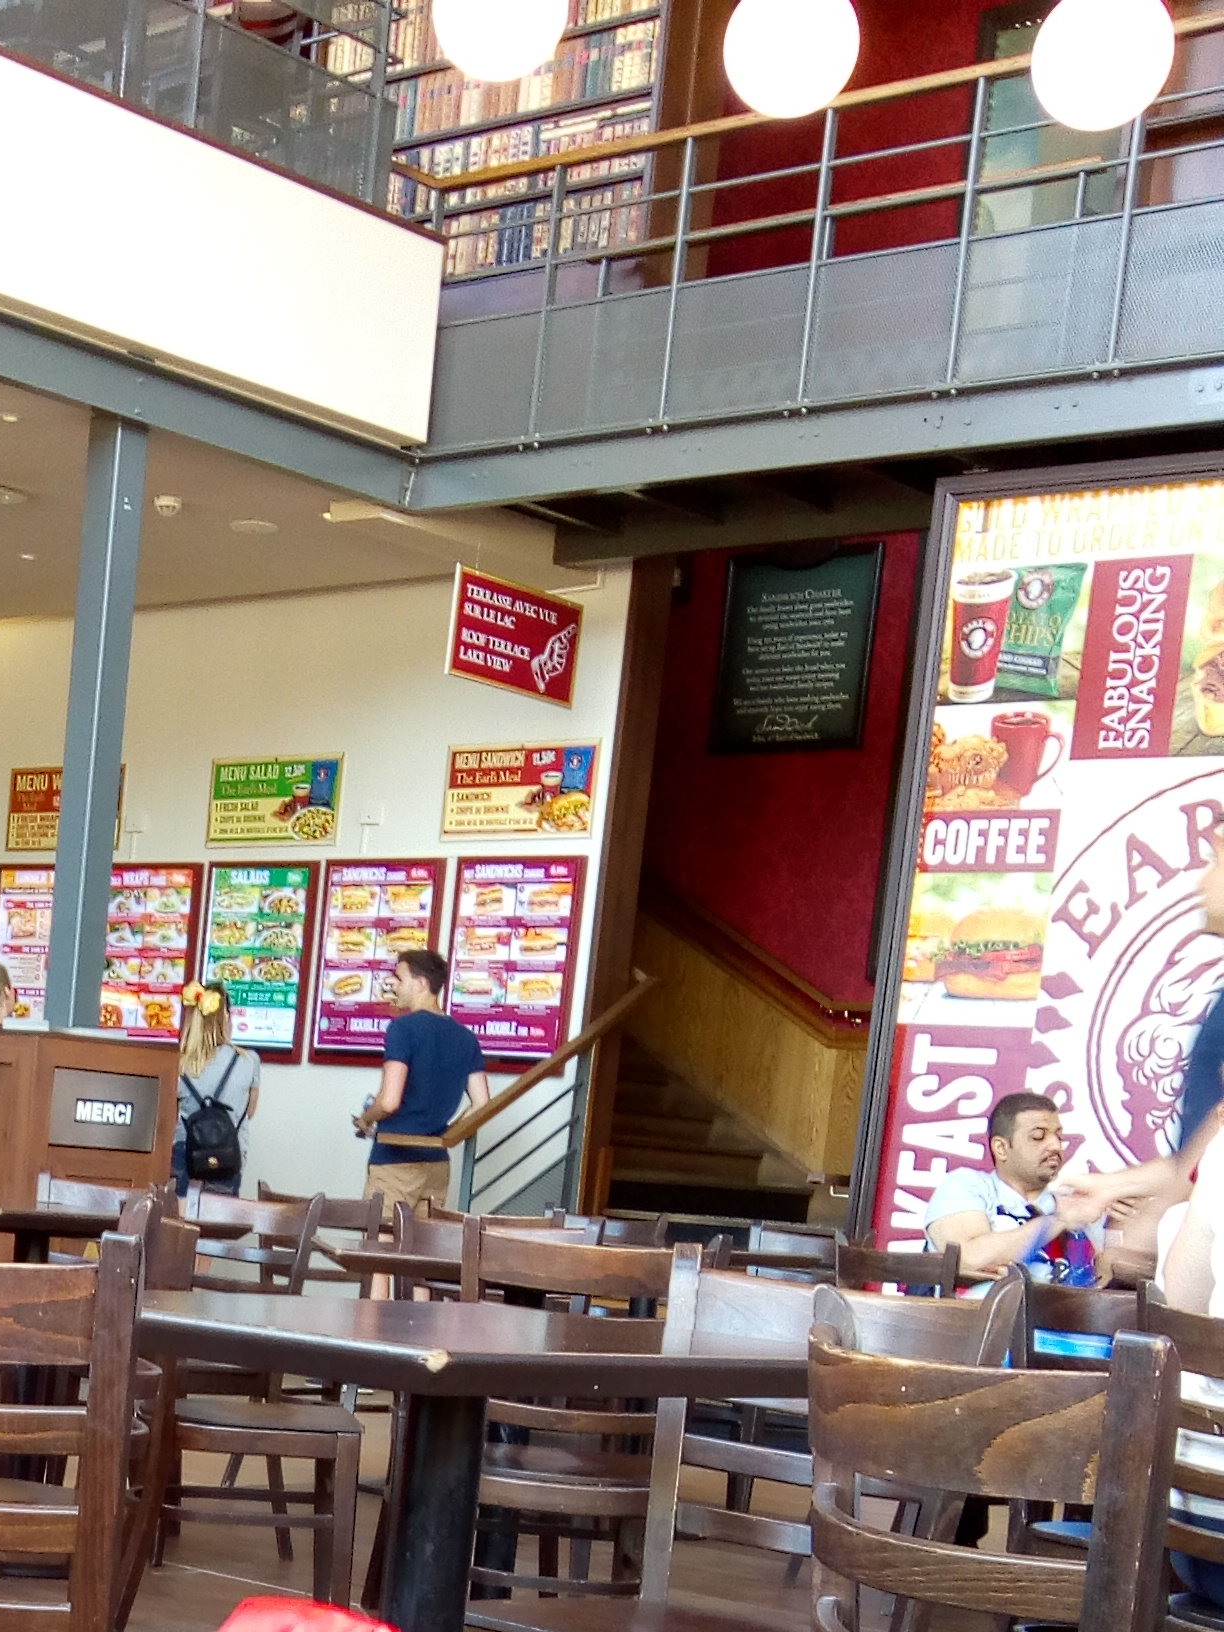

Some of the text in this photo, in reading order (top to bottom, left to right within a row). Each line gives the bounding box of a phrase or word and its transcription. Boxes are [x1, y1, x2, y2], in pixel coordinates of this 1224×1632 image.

[463, 601, 516, 629] SUR LE LAC
[466, 583, 558, 625] TERRASSE AVEC VUE
[461, 627, 531, 661] ROOF TERRACE
[1124, 565, 1172, 749] SNACKING
[459, 645, 513, 672] LAKE VIEW
[1098, 568, 1145, 750] FABULOUS
[220, 765, 247, 782] MENU
[249, 764, 279, 781] SALAD
[455, 752, 480, 769] MENU
[16, 773, 48, 792] MENU
[923, 816, 1051, 866] COFFEE
[75, 1099, 132, 1125] MERCI
